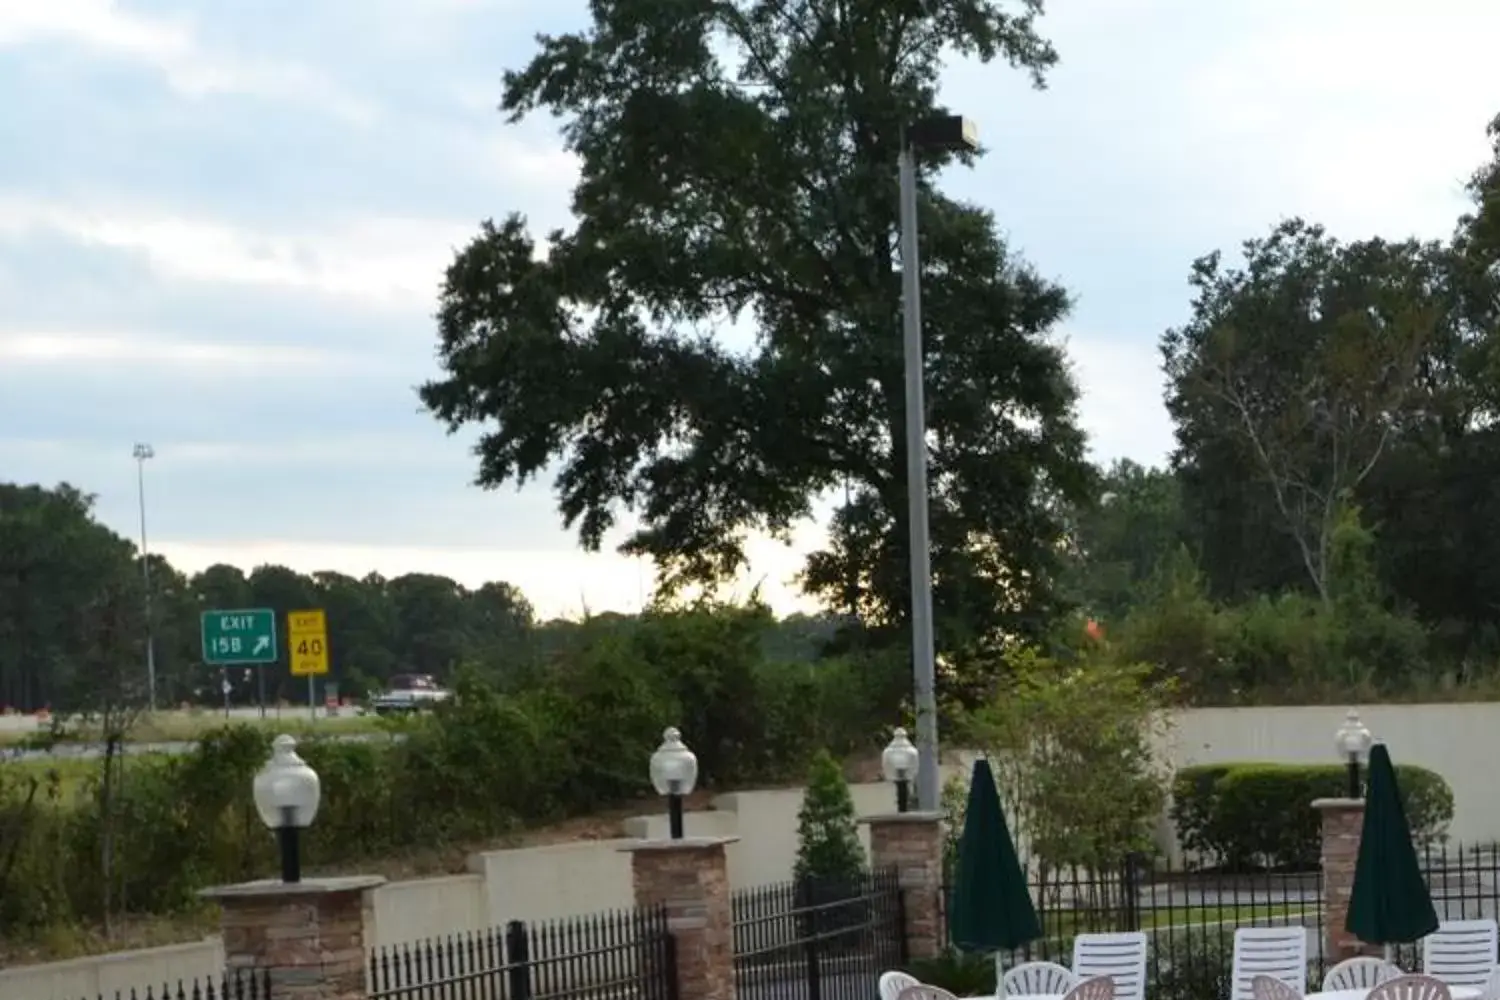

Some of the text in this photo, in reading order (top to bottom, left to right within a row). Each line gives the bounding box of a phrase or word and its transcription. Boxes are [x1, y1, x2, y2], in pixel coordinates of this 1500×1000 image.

[221, 615, 255, 630] EXIT
[211, 637, 242, 653] 15B
[298, 640, 322, 656] 40
